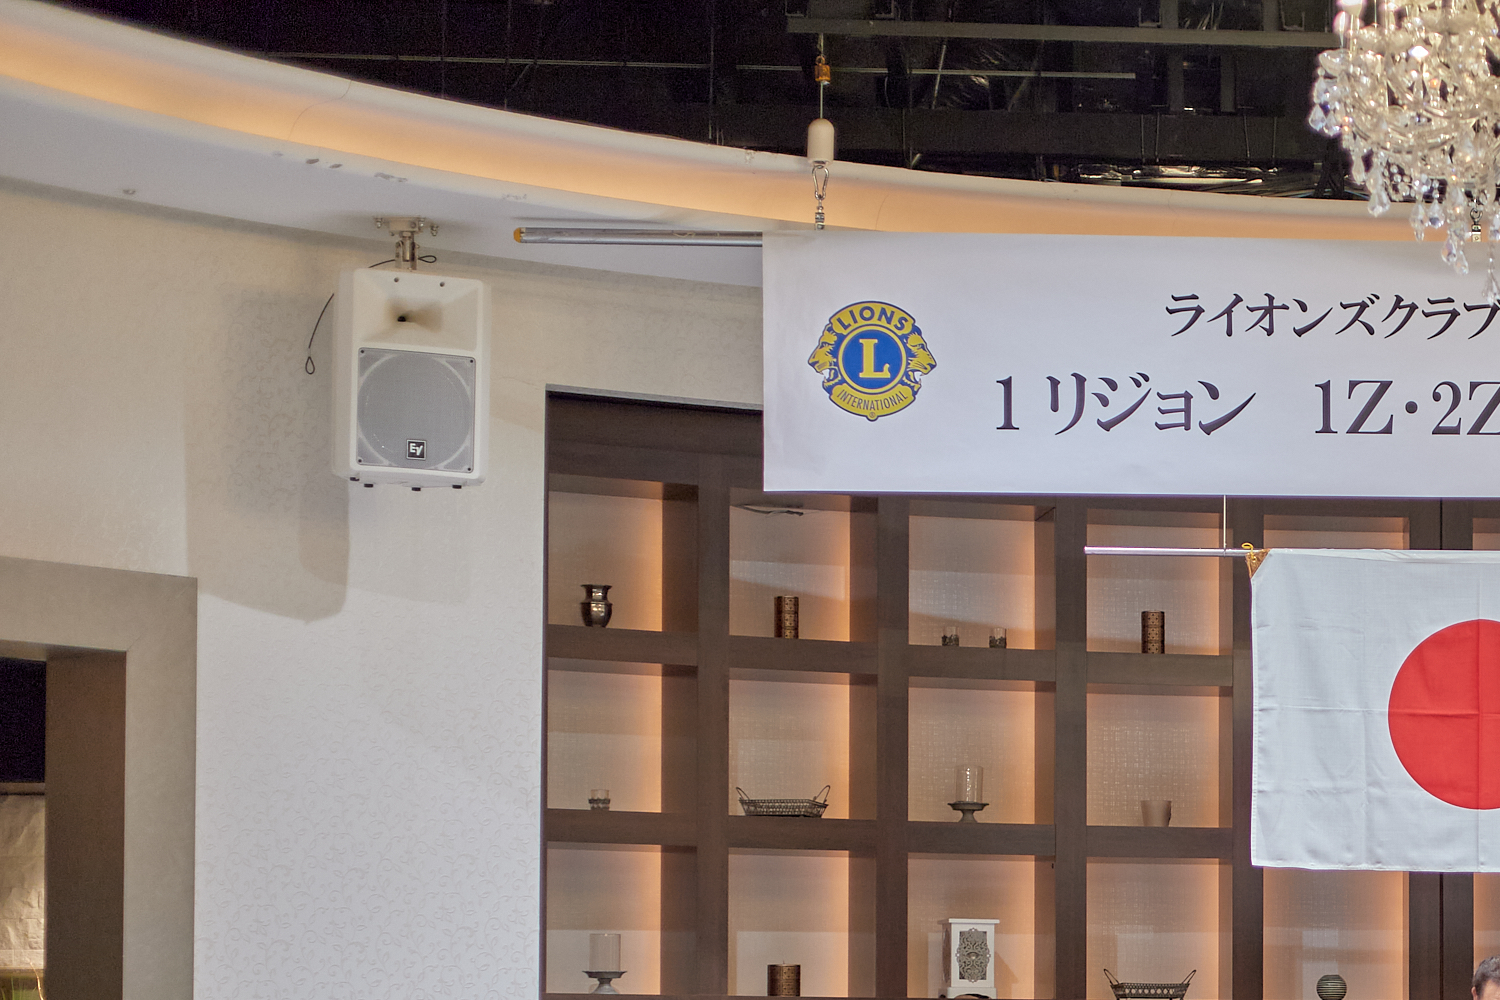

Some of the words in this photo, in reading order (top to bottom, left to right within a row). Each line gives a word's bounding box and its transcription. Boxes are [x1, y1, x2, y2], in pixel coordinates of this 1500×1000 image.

[836, 305, 909, 331] LIONS
[859, 338, 891, 379] L
[836, 389, 909, 412] INTERNATIONAL
